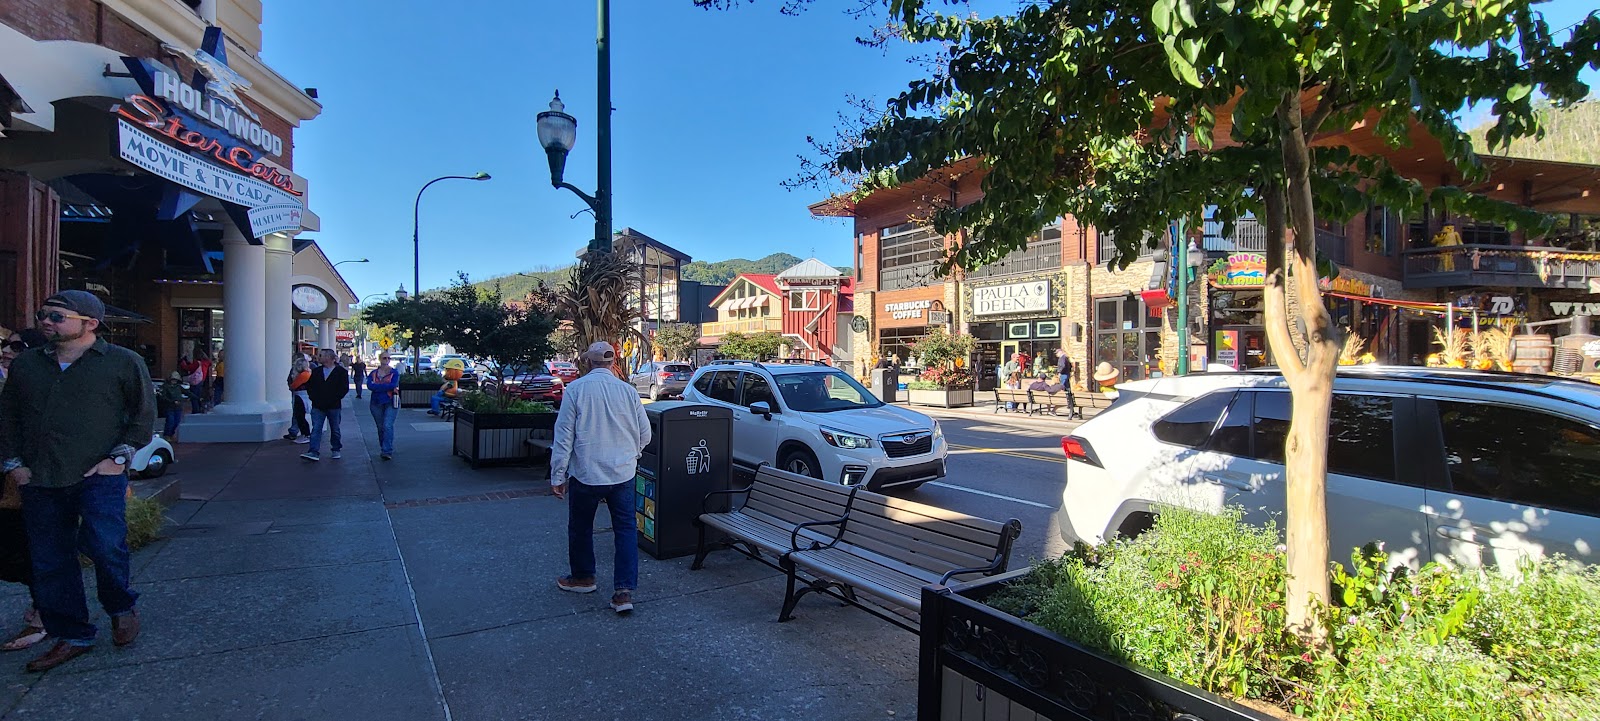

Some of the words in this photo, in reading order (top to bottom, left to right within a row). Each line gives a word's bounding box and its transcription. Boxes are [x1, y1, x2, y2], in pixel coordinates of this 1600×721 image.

[154, 71, 283, 157] HOLLYWOOD
[119, 94, 227, 163] Star
[229, 146, 303, 196] Cars
[127, 136, 190, 178] MOVIE
[195, 168, 207, 185] &
[212, 174, 234, 193] TV
[236, 182, 273, 204] CARS
[252, 213, 282, 227] MUSEUM
[1229, 254, 1263, 264] DUDE'S
[811, 278, 835, 286] GIFTS
[1217, 275, 1265, 285] DAIQUIR
[980, 285, 1029, 300] PAULA
[884, 300, 930, 312] STARBUCKS
[980, 297, 1026, 312] DEEN
[1490, 296, 1515, 314] 7D
[892, 310, 922, 320] COFFEE
